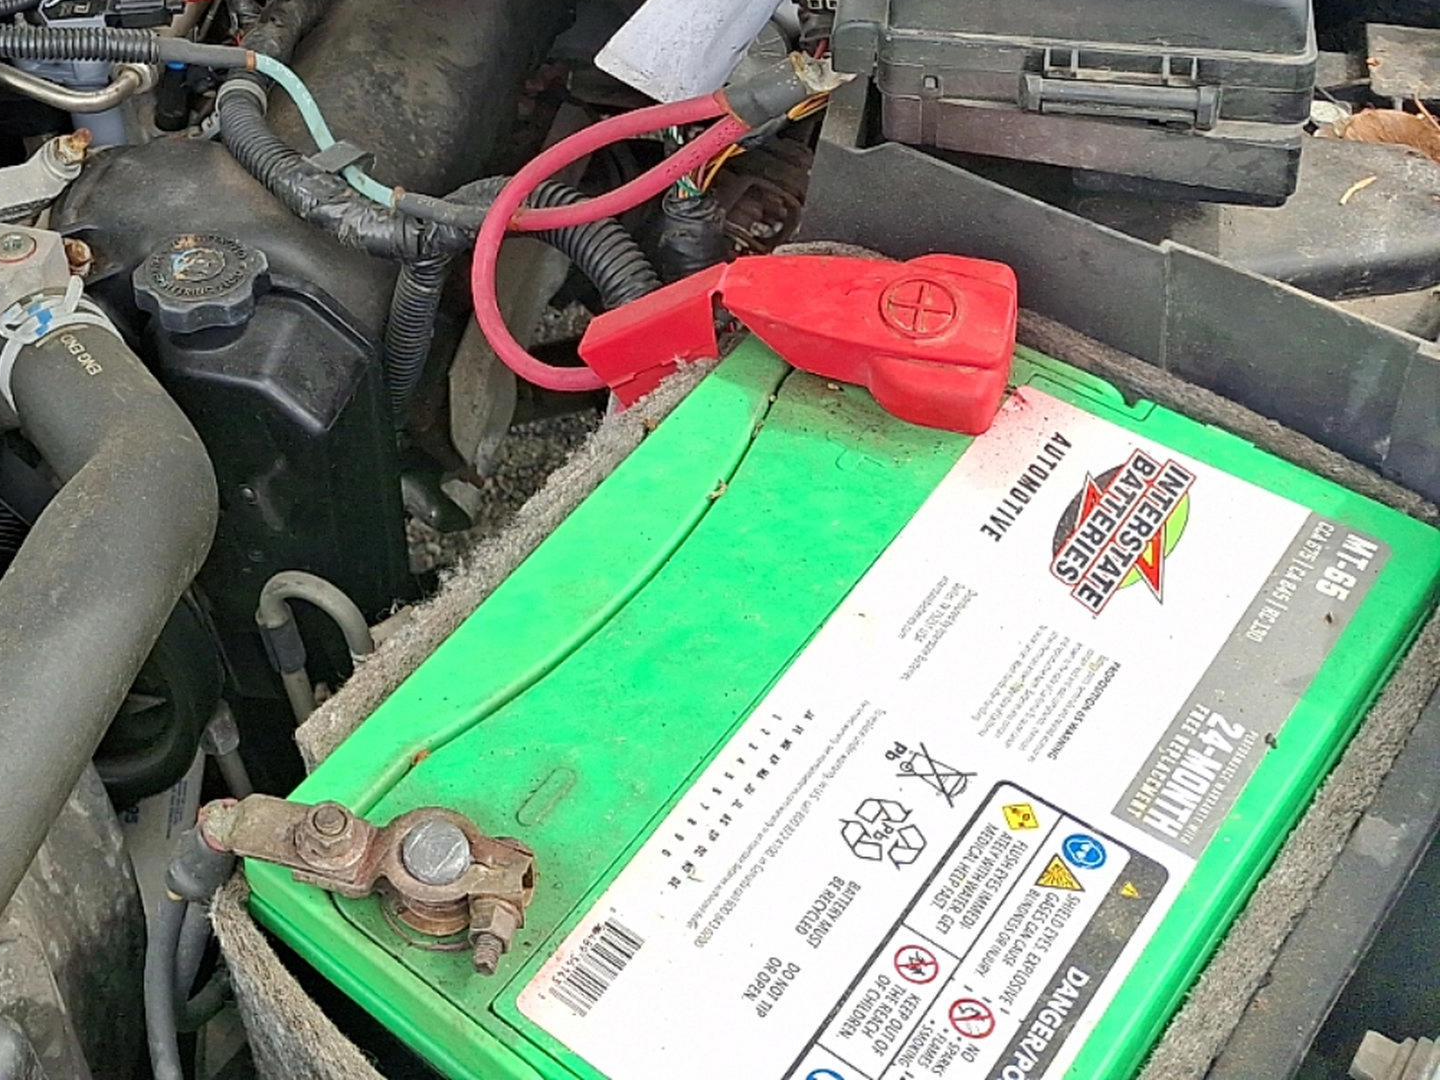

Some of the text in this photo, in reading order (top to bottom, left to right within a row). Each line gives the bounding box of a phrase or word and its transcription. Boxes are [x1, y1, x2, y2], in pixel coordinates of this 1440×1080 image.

[61, 335, 103, 375] ENG END
[980, 432, 1072, 542] AUTOMOTIVE
[1051, 450, 1156, 587] BATTERIES
[1077, 461, 1190, 612] INTERSTATE
[1245, 521, 1334, 642] CCA 675 CA 845 RC 130
[1312, 534, 1378, 601] MT-65
[1047, 662, 1121, 760] PROPOSITION 65 WARNING
[885, 741, 908, 761] Pb
[1127, 703, 1210, 819] FREE REPLACEMENT
[1142, 713, 1244, 842] 24-MONTH
[873, 820, 894, 841] Pb
[963, 823, 999, 863] MEDICAL
[989, 832, 1012, 859] ATELY
[949, 862, 970, 888] HELP
[972, 857, 996, 882] WITH
[1001, 840, 1028, 870] FLUSH
[985, 867, 1008, 892] EYES
[795, 876, 845, 935] BE RECYCLED
[806, 881, 861, 949] BATTERY MUST
[936, 914, 955, 935] GET
[1004, 889, 1041, 933] BLINDNESS
[1051, 893, 1080, 928] SHIELD
[995, 932, 1010, 947] OR
[1002, 892, 1059, 967] GASES CAN CAUSE
[763, 957, 782, 974] OR
[874, 974, 891, 992] OF
[999, 952, 1041, 1005] EXPLOSIVE
[756, 963, 800, 1018] DO NOT TIP
[861, 984, 907, 1039] THE REACH
[872, 993, 921, 1057] KEEP OUT OF
[996, 963, 1092, 1080] DANGER/PO
[918, 1033, 947, 1068] FLAMES
[931, 1042, 960, 1077] SPARKS
[961, 1044, 980, 1063] NO
